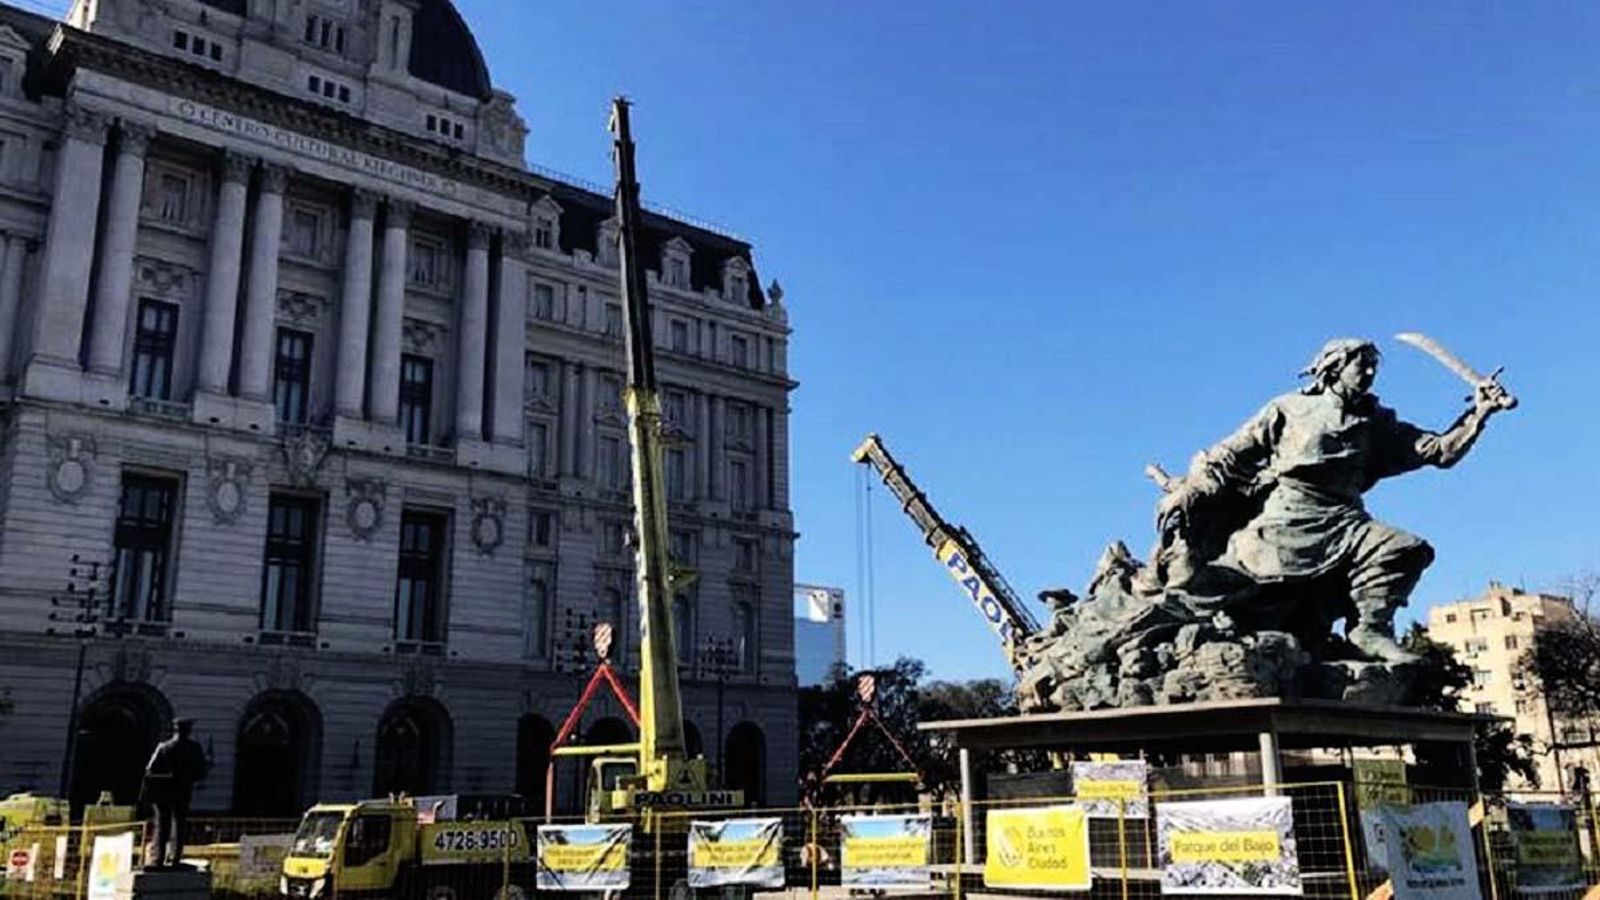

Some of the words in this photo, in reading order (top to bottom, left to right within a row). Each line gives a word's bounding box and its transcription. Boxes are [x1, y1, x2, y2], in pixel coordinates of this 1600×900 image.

[200, 109, 270, 137] CENTRO
[274, 129, 362, 165] CULTURAL
[634, 791, 733, 805] PAOLINI
[1027, 841, 1056, 854] Aires
[1173, 840, 1216, 856] Parque
[1220, 838, 1240, 852] del
[1243, 837, 1274, 855] Bajo
[1028, 855, 1067, 869] Ciudad
